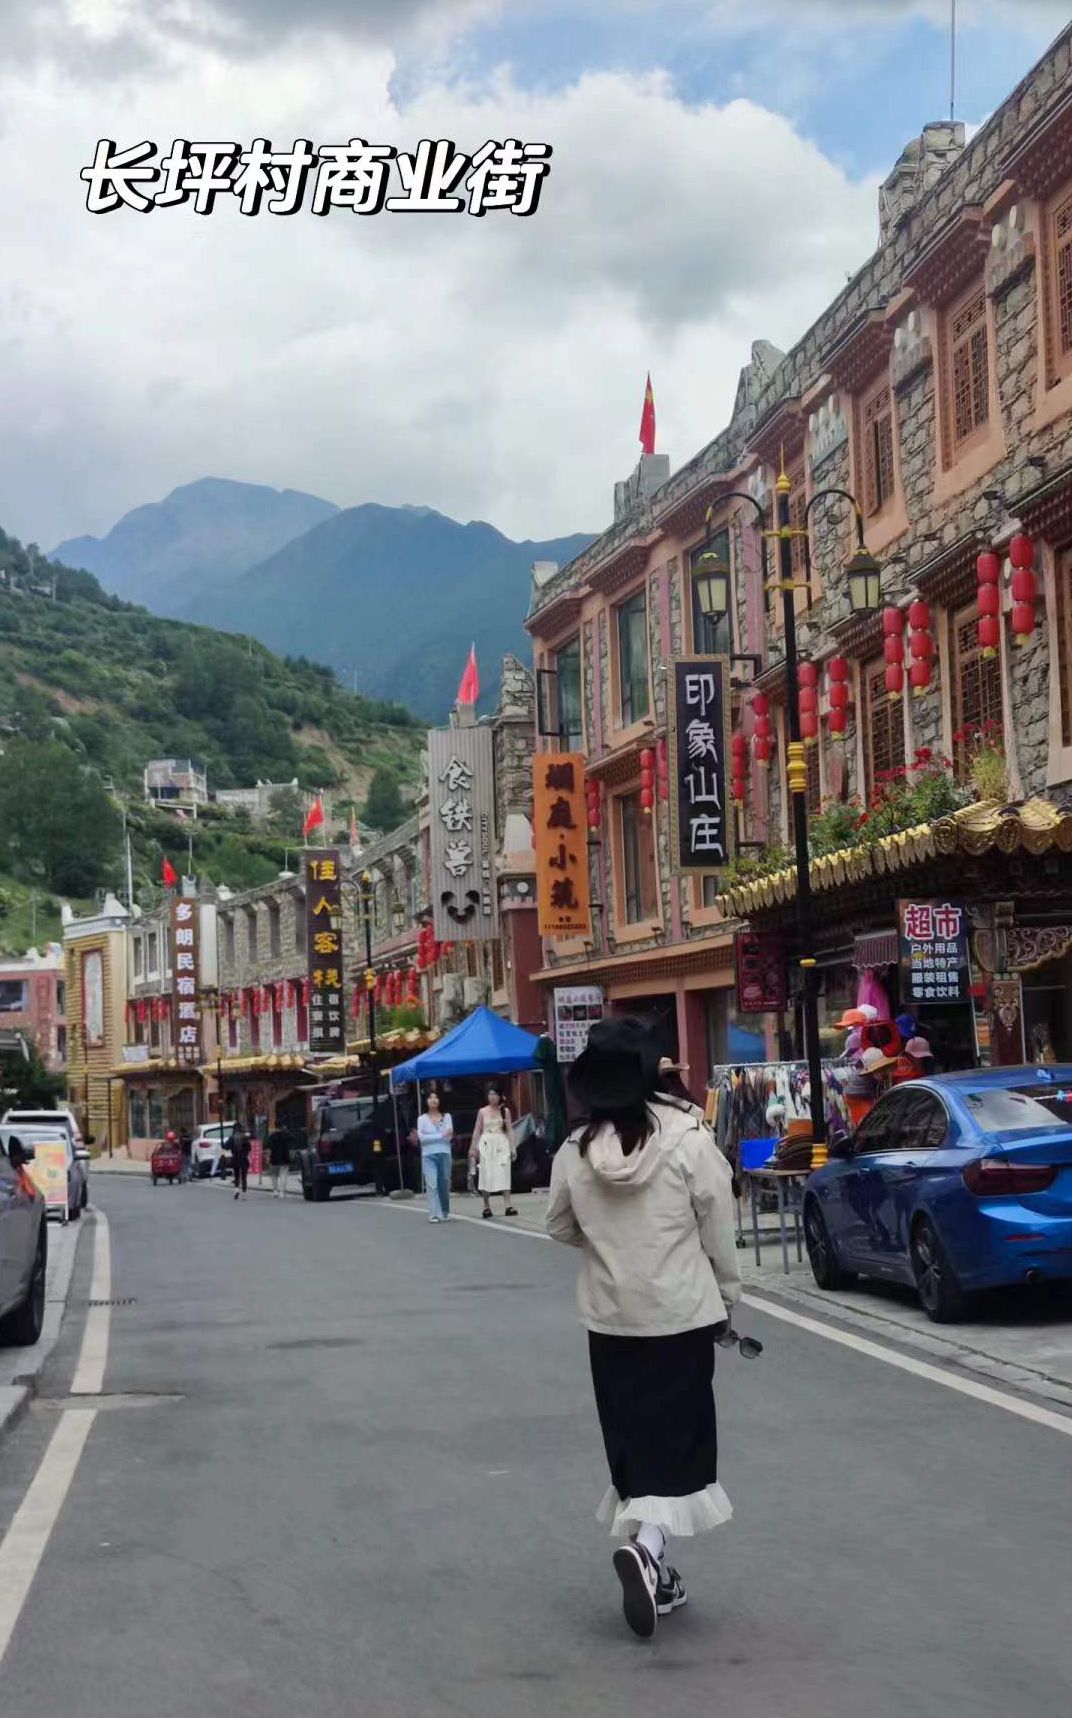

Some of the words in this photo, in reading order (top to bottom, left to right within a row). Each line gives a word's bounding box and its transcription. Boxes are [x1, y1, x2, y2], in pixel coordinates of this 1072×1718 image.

[685, 674, 723, 858] 印象山庄
[310, 860, 342, 990] 佳人客栈
[905, 903, 962, 940] 超市
[911, 942, 958, 955] 户外用品
[911, 957, 959, 969] 当地特产
[175, 903, 198, 1043] 多朗民宿酒店
[912, 986, 960, 998] 零食饮料
